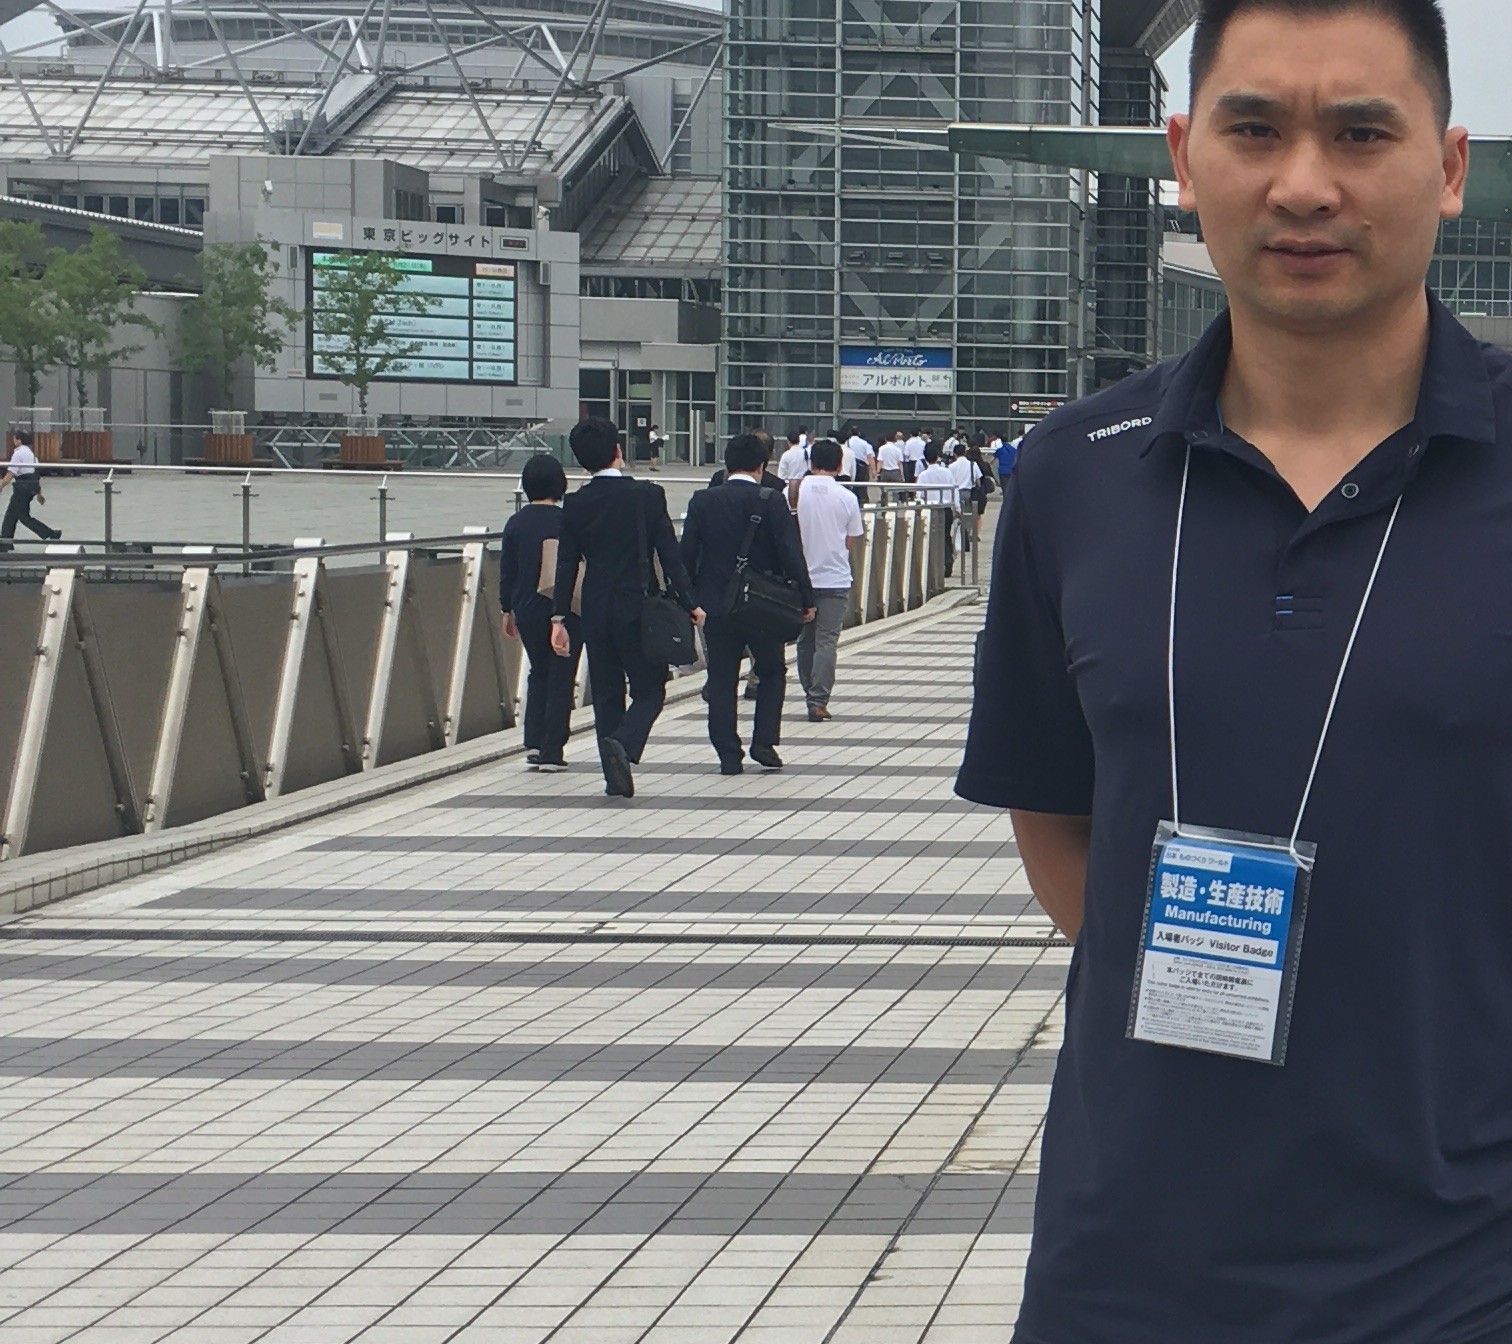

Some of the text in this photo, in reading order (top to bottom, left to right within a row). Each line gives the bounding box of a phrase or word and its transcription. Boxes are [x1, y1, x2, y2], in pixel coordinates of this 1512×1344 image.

[363, 227, 490, 248] 東京ビッグサイト
[862, 374, 927, 387] アルポルト
[1087, 416, 1152, 442] TRIBORD
[1160, 872, 1284, 915] 製造・生産技術
[1165, 904, 1272, 935] Manufacturing
[1156, 930, 1274, 958] 入場者バッジ Visitor Badge
